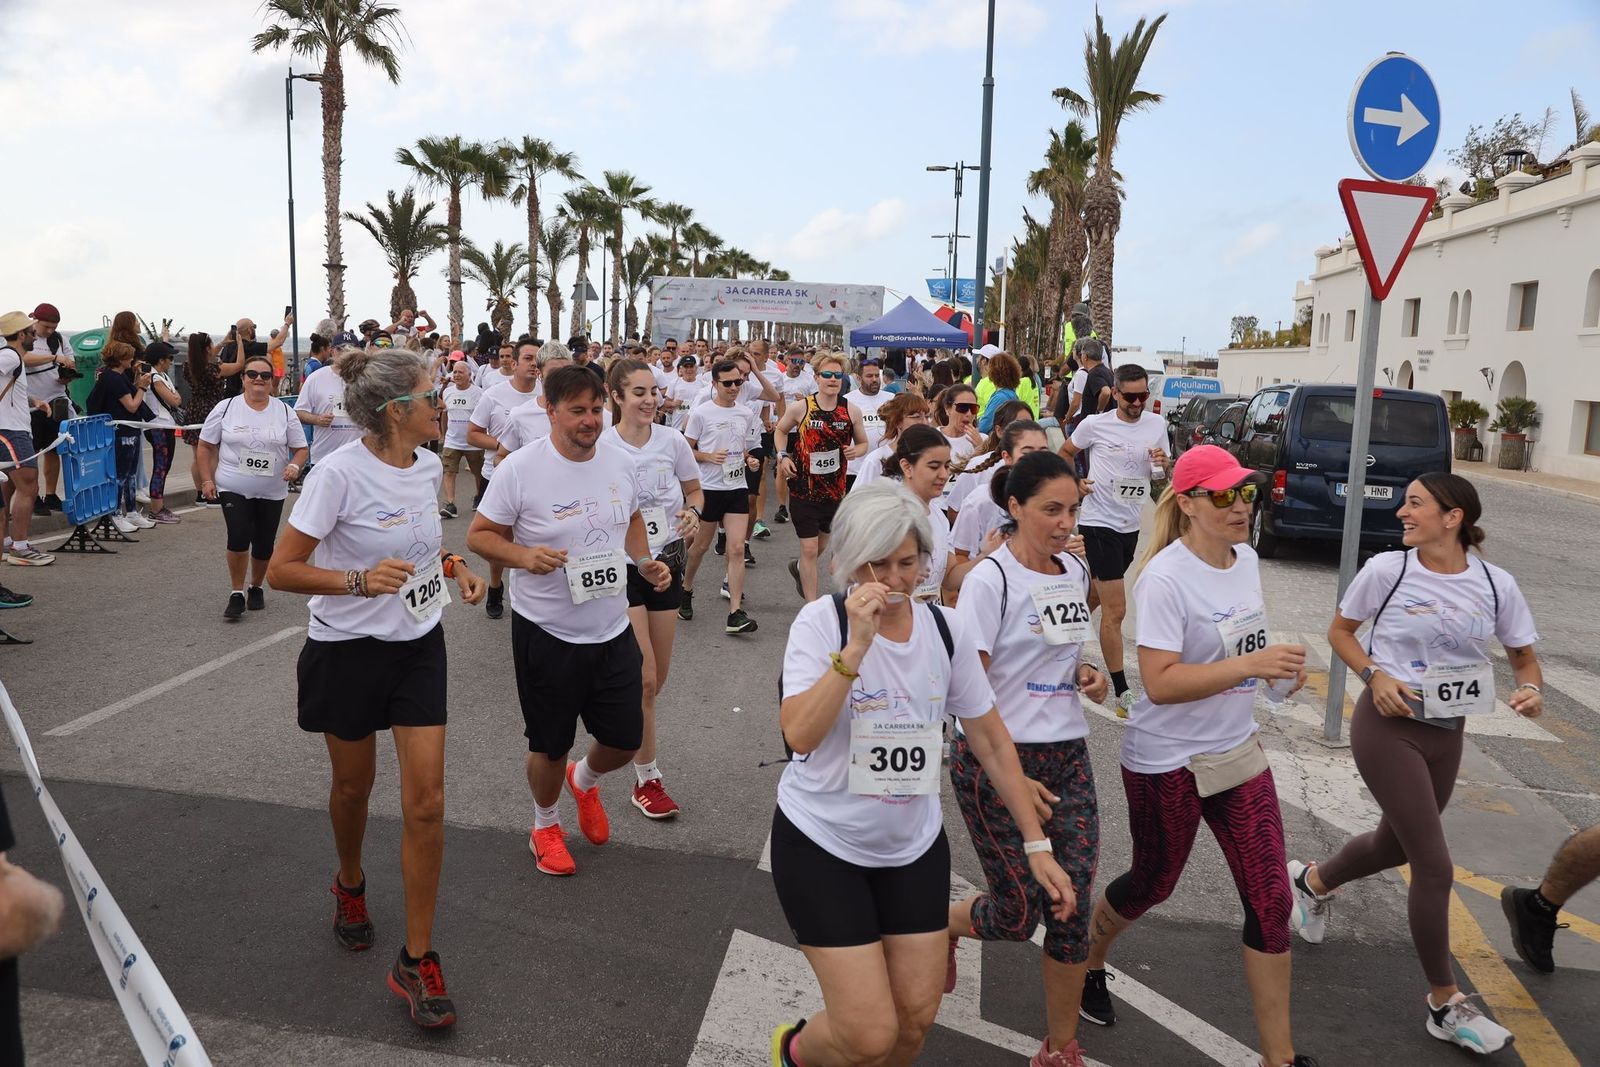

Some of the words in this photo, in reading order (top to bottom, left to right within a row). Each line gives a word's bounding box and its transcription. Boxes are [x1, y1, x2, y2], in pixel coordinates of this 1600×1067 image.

[725, 286, 739, 295] 3A
[742, 286, 792, 297] CARRERA
[795, 289, 808, 297] 5K
[873, 334, 946, 342] info@dorsalchip.es
[246, 457, 269, 469] 962
[815, 458, 835, 468] 456
[1120, 485, 1145, 497] 775
[1370, 487, 1389, 497] HNR
[581, 566, 618, 588] 856
[405, 573, 441, 608] 1205
[1043, 602, 1090, 626] 1225
[1235, 628, 1266, 657] 186
[1438, 679, 1481, 702] 674
[869, 746, 927, 773] 309
